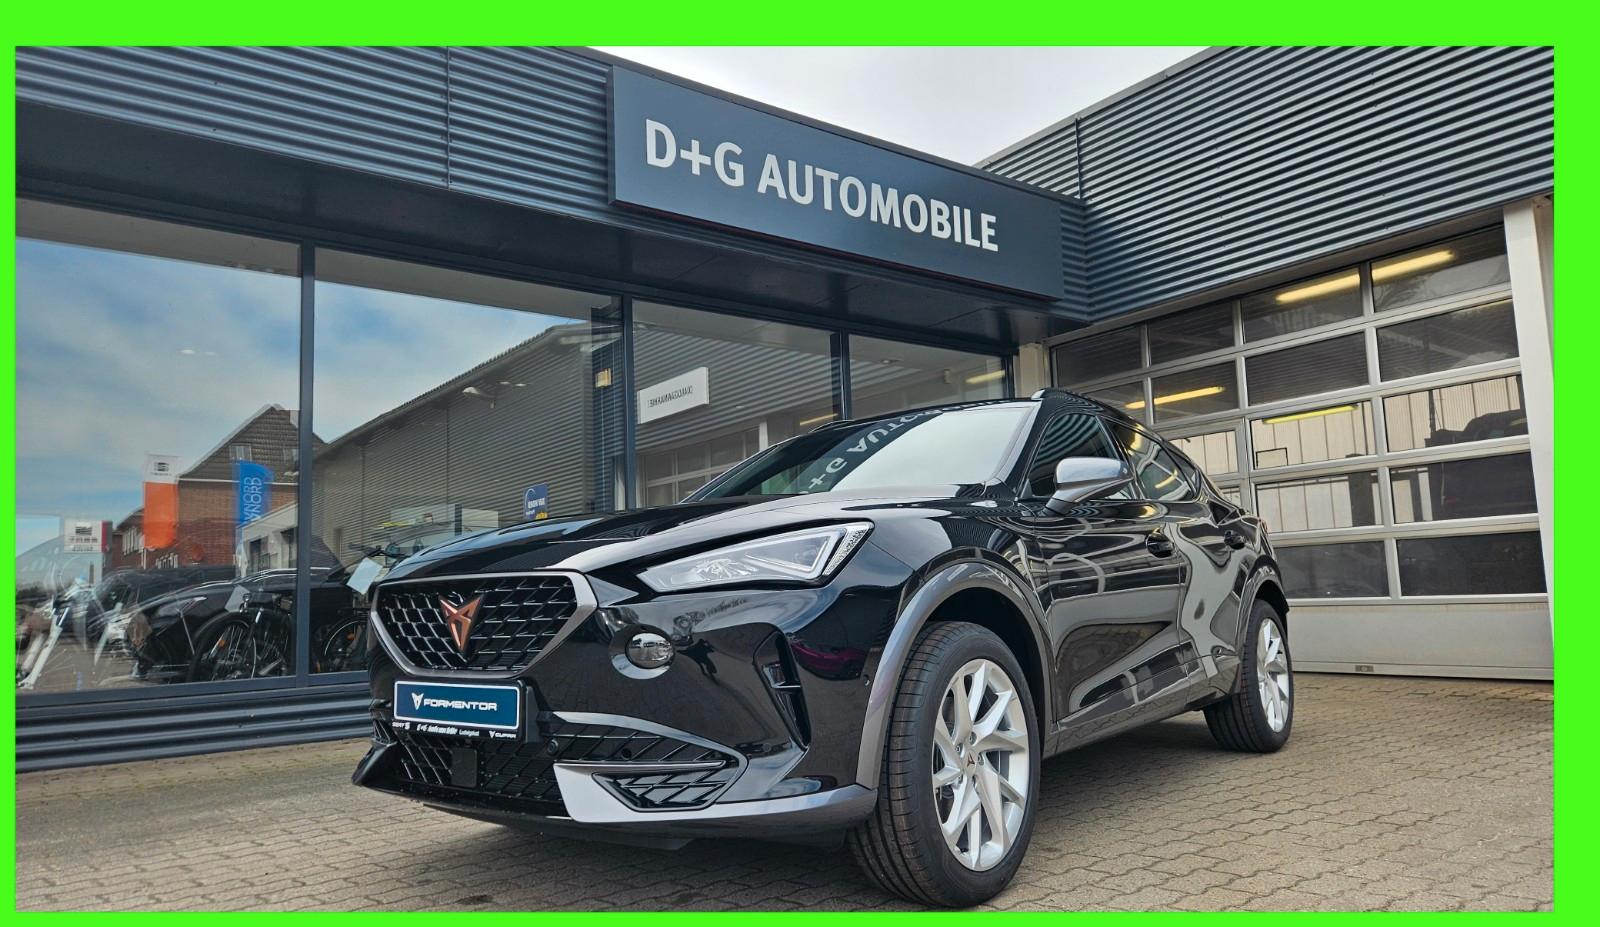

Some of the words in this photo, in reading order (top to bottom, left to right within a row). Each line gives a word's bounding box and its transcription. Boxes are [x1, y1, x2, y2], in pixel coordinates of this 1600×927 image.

[646, 119, 744, 187] D+G
[757, 154, 998, 252] AUTOMOBILE
[423, 698, 497, 711] FORMENTOR
